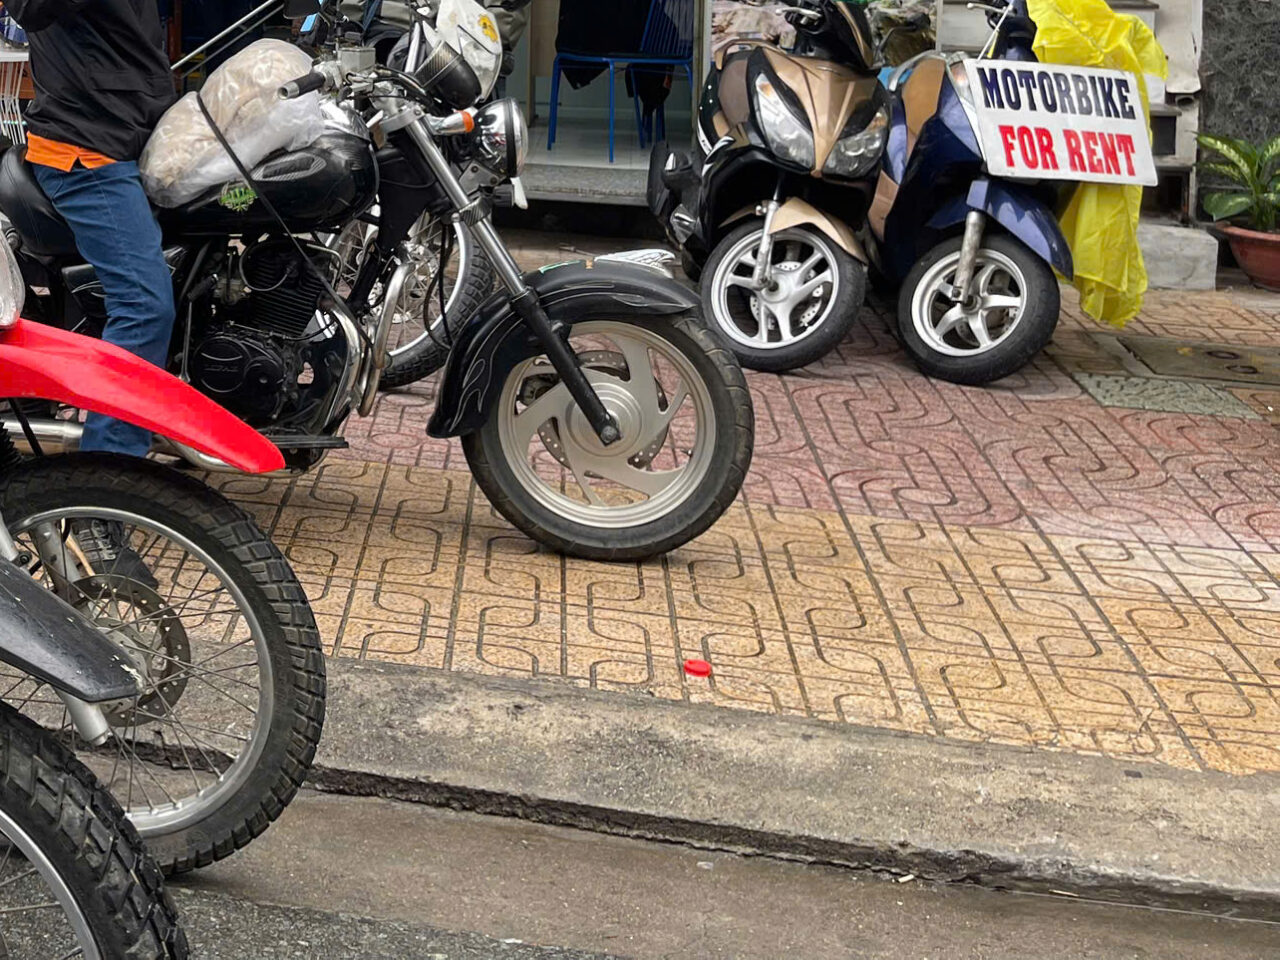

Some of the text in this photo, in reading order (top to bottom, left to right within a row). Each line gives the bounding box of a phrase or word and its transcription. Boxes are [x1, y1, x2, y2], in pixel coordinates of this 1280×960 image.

[977, 66, 1137, 120] MOTORBIKE
[998, 124, 1136, 177] FOR RENT
